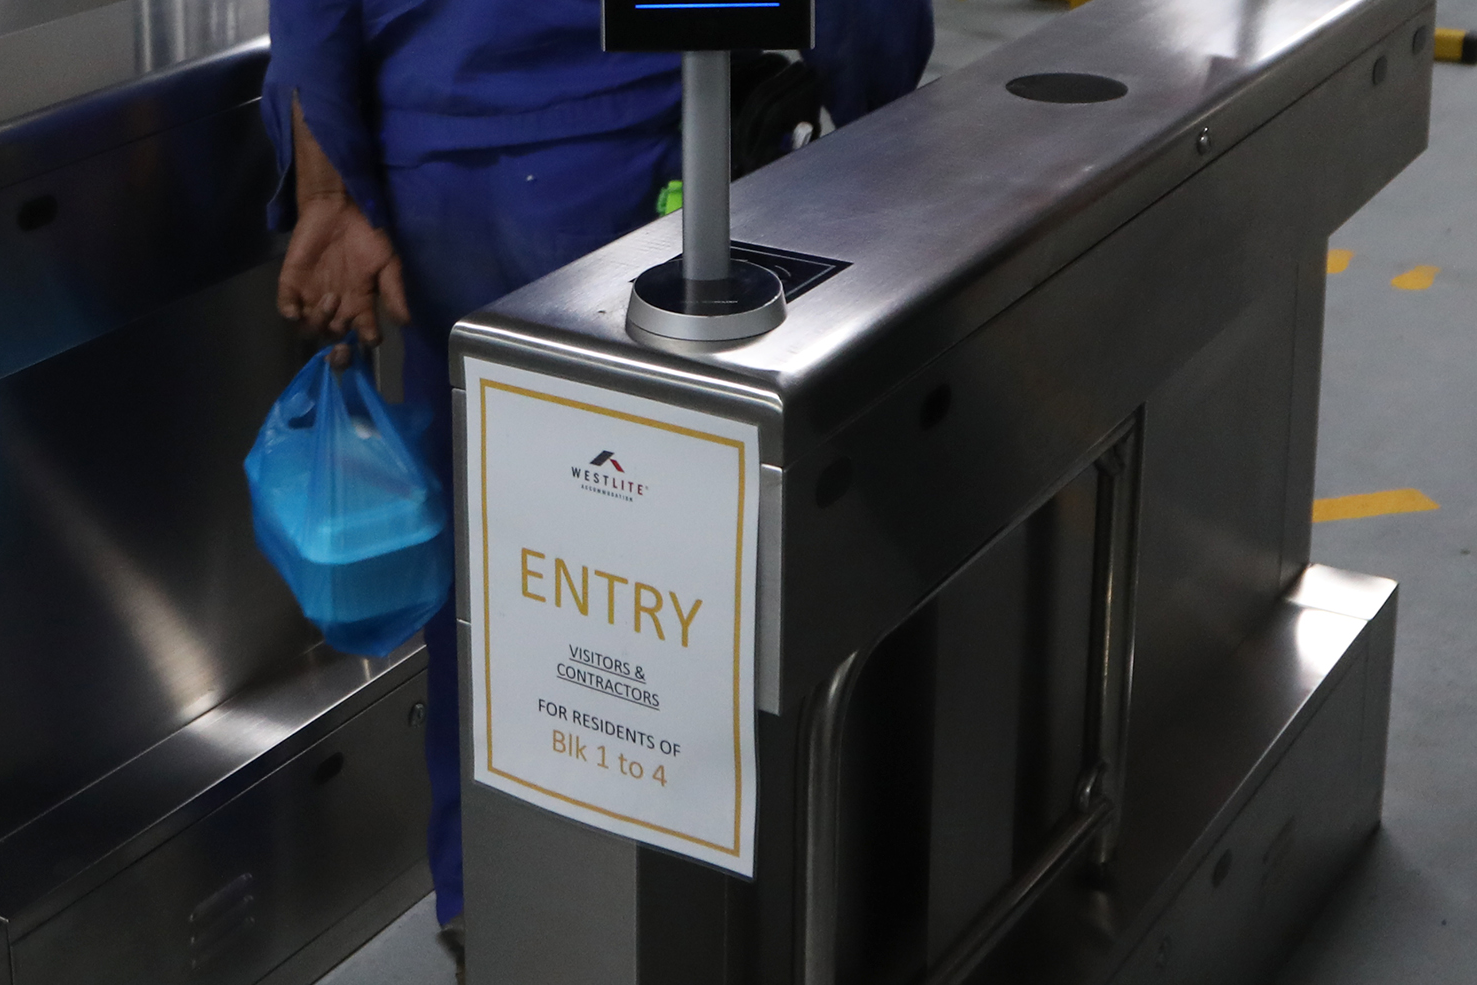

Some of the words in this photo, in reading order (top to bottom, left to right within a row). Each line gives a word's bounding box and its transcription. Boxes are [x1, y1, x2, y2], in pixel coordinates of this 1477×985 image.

[571, 466, 644, 496] WESTLITE
[521, 547, 703, 648] ENTRY
[556, 662, 661, 708] CONTRACTORS
[568, 644, 631, 676] VISITORS
[634, 666, 646, 680] &
[538, 698, 568, 722] FOR
[572, 709, 656, 750] RESIDENTS
[659, 739, 681, 758] OF
[552, 729, 588, 763] Blk
[596, 745, 609, 770] 1
[618, 752, 644, 780] to
[652, 765, 668, 788] 4
